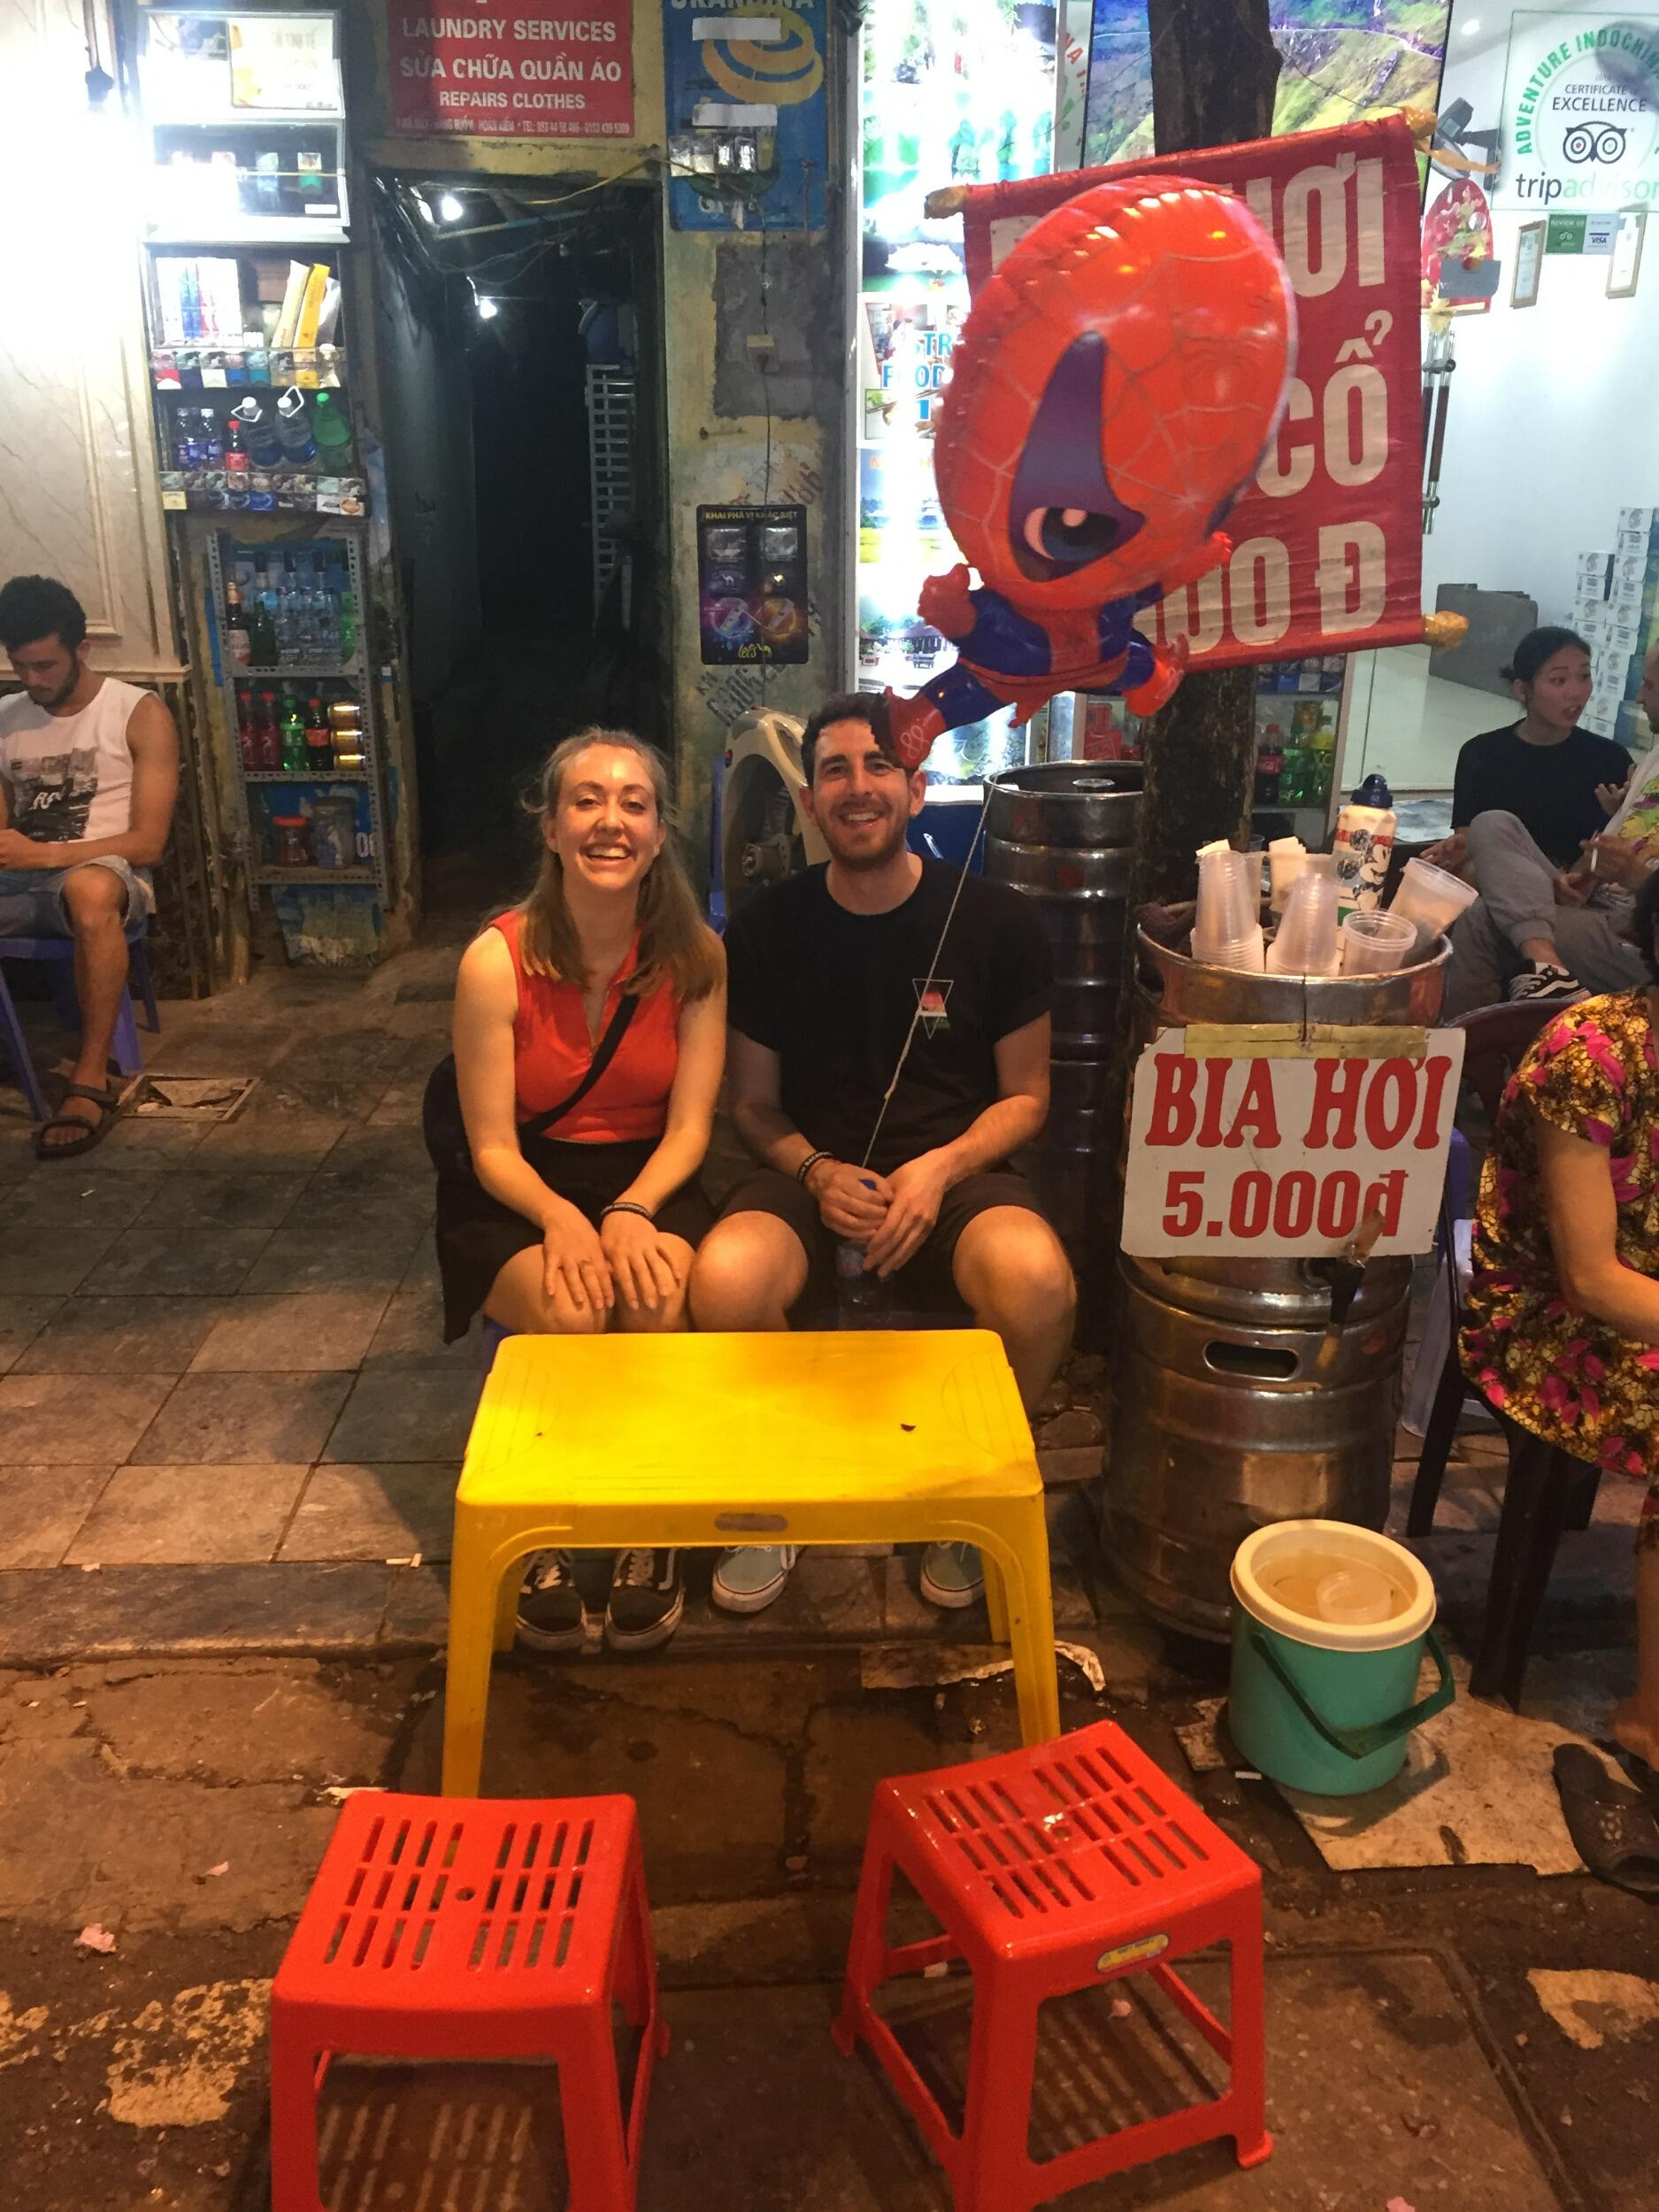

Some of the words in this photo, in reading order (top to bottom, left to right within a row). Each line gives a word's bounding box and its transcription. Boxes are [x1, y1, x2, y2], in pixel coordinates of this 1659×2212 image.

[403, 18, 507, 39] LAUNDRY
[513, 19, 617, 42] SERVICES
[400, 50, 447, 78] SỬA
[452, 53, 514, 80] CHỮA
[520, 51, 584, 81] QUẦN
[589, 56, 622, 82] ÁO
[439, 91, 508, 107] REPAIRS
[512, 92, 586, 109] CLOTHES
[1516, 42, 1572, 155] ADVENTURE
[1552, 96, 1648, 112] EXCELLENCE
[1564, 84, 1629, 96] CERTIFICATE
[1315, 521, 1386, 635] Đ
[1144, 1053, 1282, 1148] BIA
[1302, 1055, 1453, 1149] HƠI
[1162, 1169, 1409, 1239] 5.000đ
